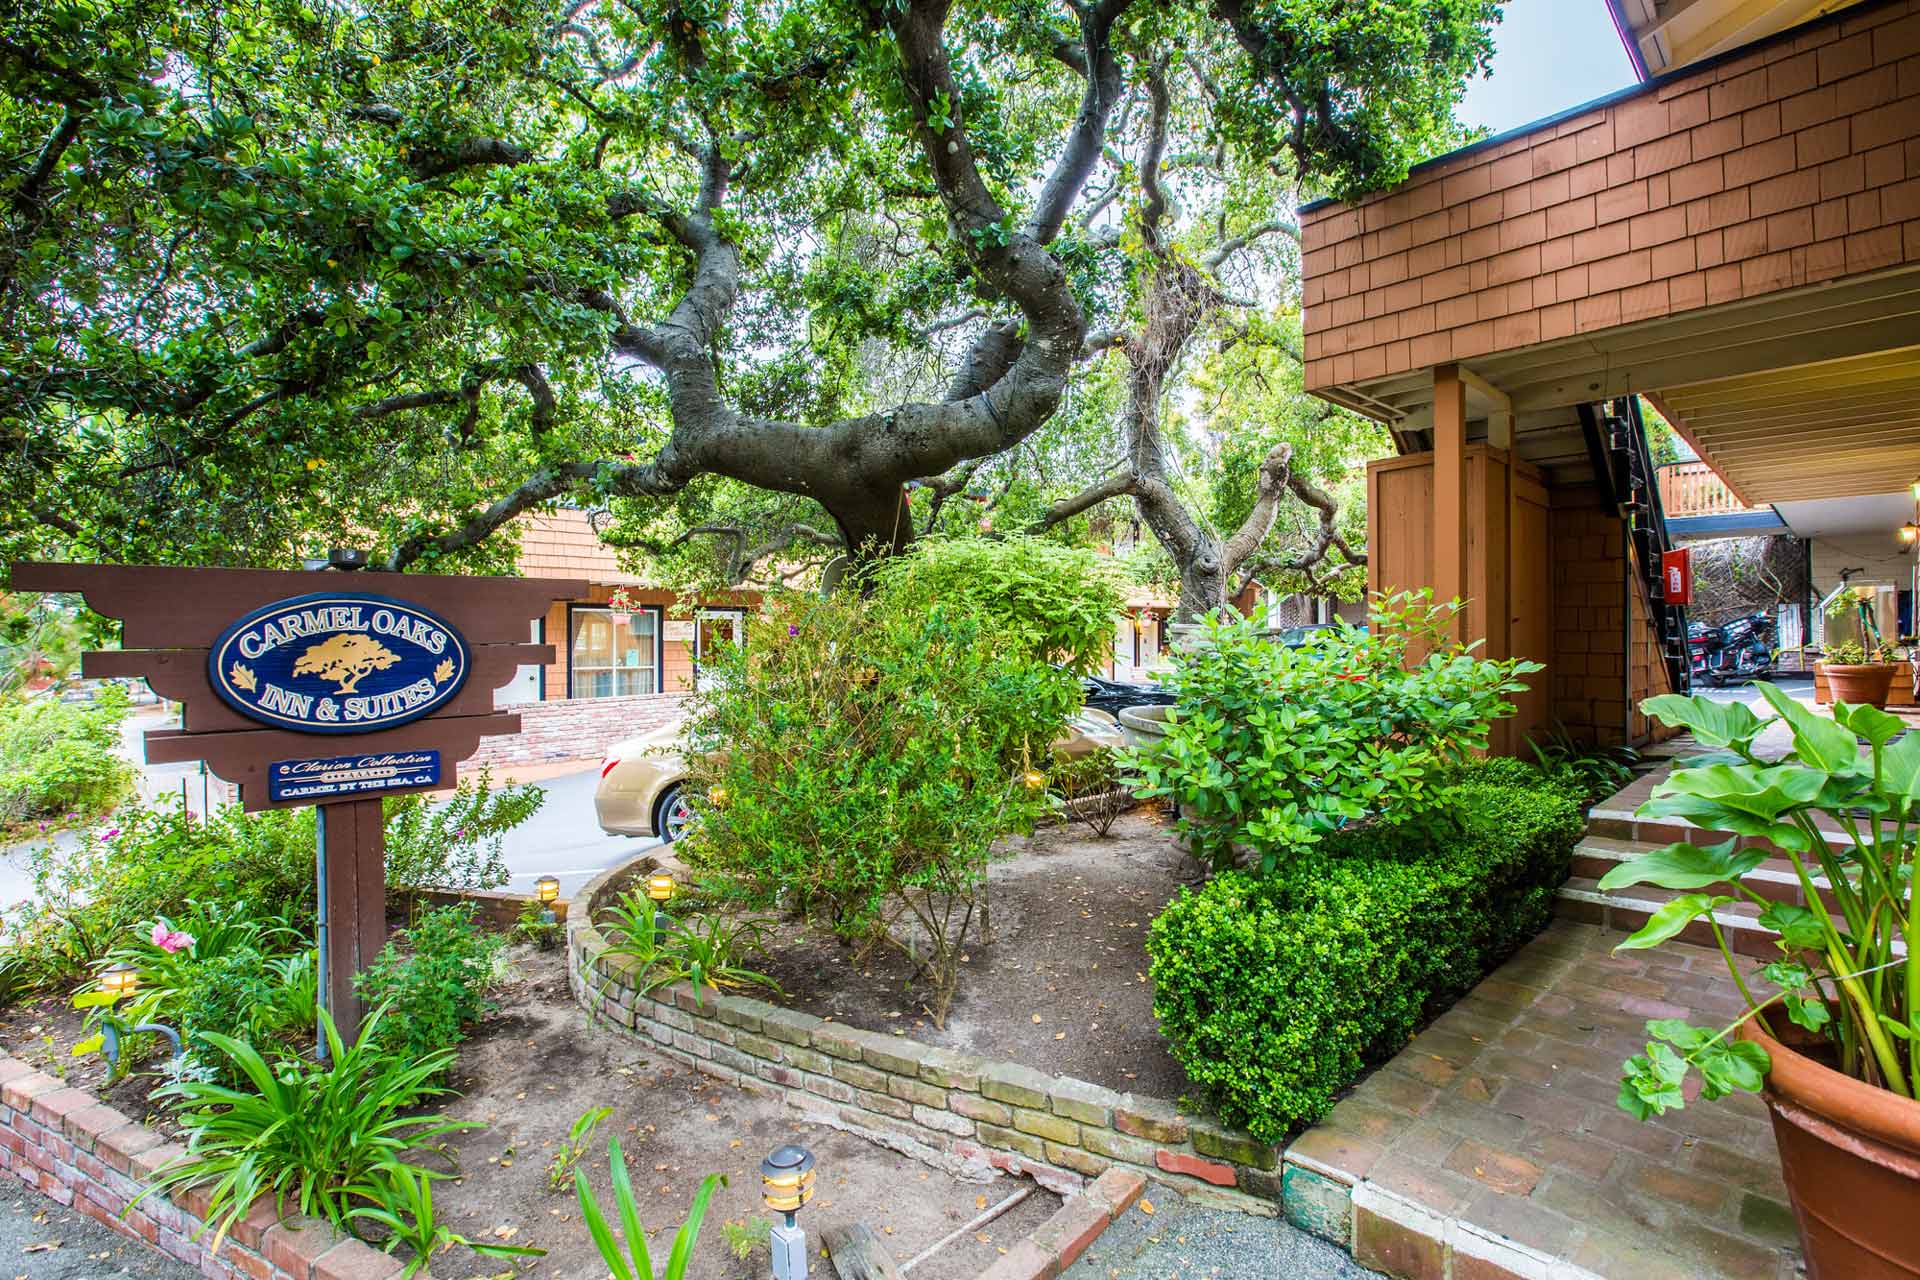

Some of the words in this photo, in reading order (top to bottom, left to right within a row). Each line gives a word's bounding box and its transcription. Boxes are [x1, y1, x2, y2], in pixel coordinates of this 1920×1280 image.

[240, 607, 370, 659] CARMEL
[372, 610, 448, 654] OAKS
[257, 683, 314, 720] INN
[316, 697, 339, 721] &
[344, 678, 437, 721] SUITES
[291, 760, 352, 773] Clarion
[357, 754, 432, 768] Collection
[280, 784, 338, 797] CARMEL
[339, 782, 357, 791] BY
[414, 775, 432, 784] CA
